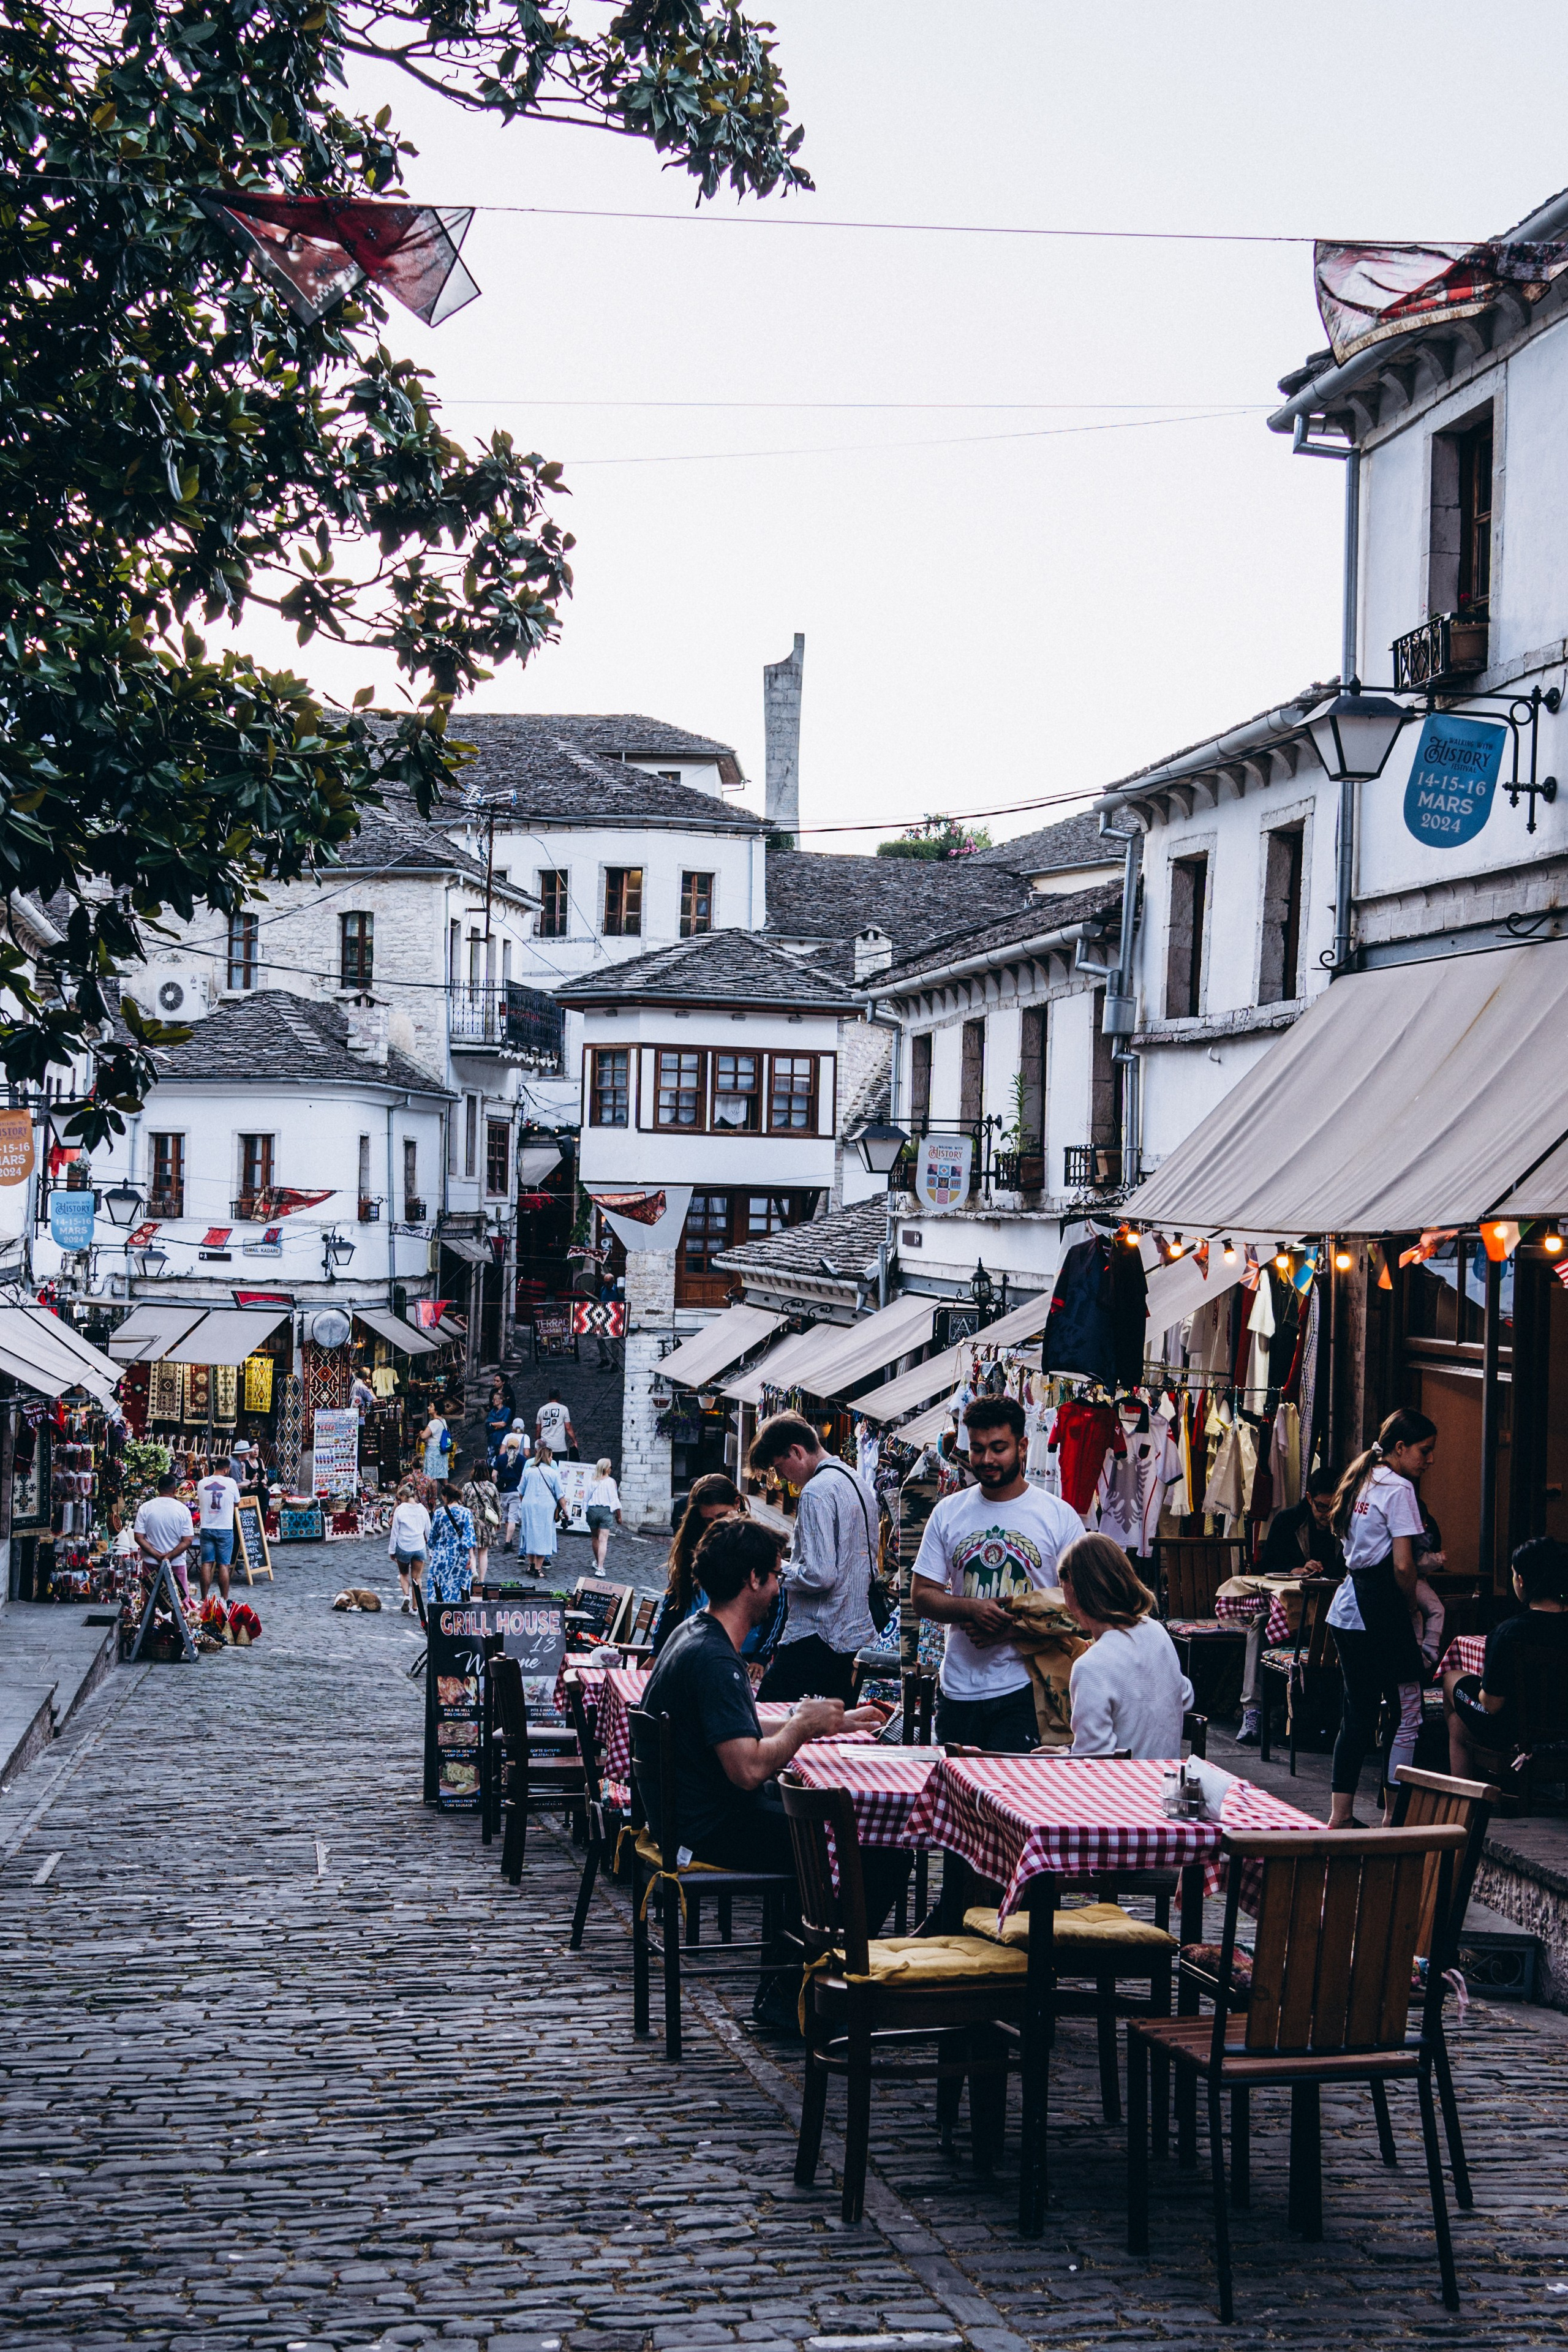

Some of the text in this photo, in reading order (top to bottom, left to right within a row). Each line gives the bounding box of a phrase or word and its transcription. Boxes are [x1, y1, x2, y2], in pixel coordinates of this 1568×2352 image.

[1449, 737, 1474, 747] WALKING
[1424, 736, 1491, 772] HISTORY
[1451, 763, 1477, 773] FESTIVAL
[1417, 771, 1486, 796] 14-15-16
[1417, 791, 1474, 815] MARS
[1421, 813, 1461, 832] 2024
[0, 1127, 27, 1137] ISTORY
[929, 1145, 963, 1160] HISTORY
[0, 1154, 26, 1165] ARS
[55, 1202, 91, 1215] HISTORY
[56, 1217, 91, 1226] 14-15-16
[59, 1226, 88, 1235] MARS
[535, 1318, 570, 1329] TERRAC
[1354, 1501, 1370, 1515] USE
[440, 1610, 492, 1636] GRILL
[496, 1610, 561, 1636] HOUSE
[530, 1636, 557, 1653] 13
